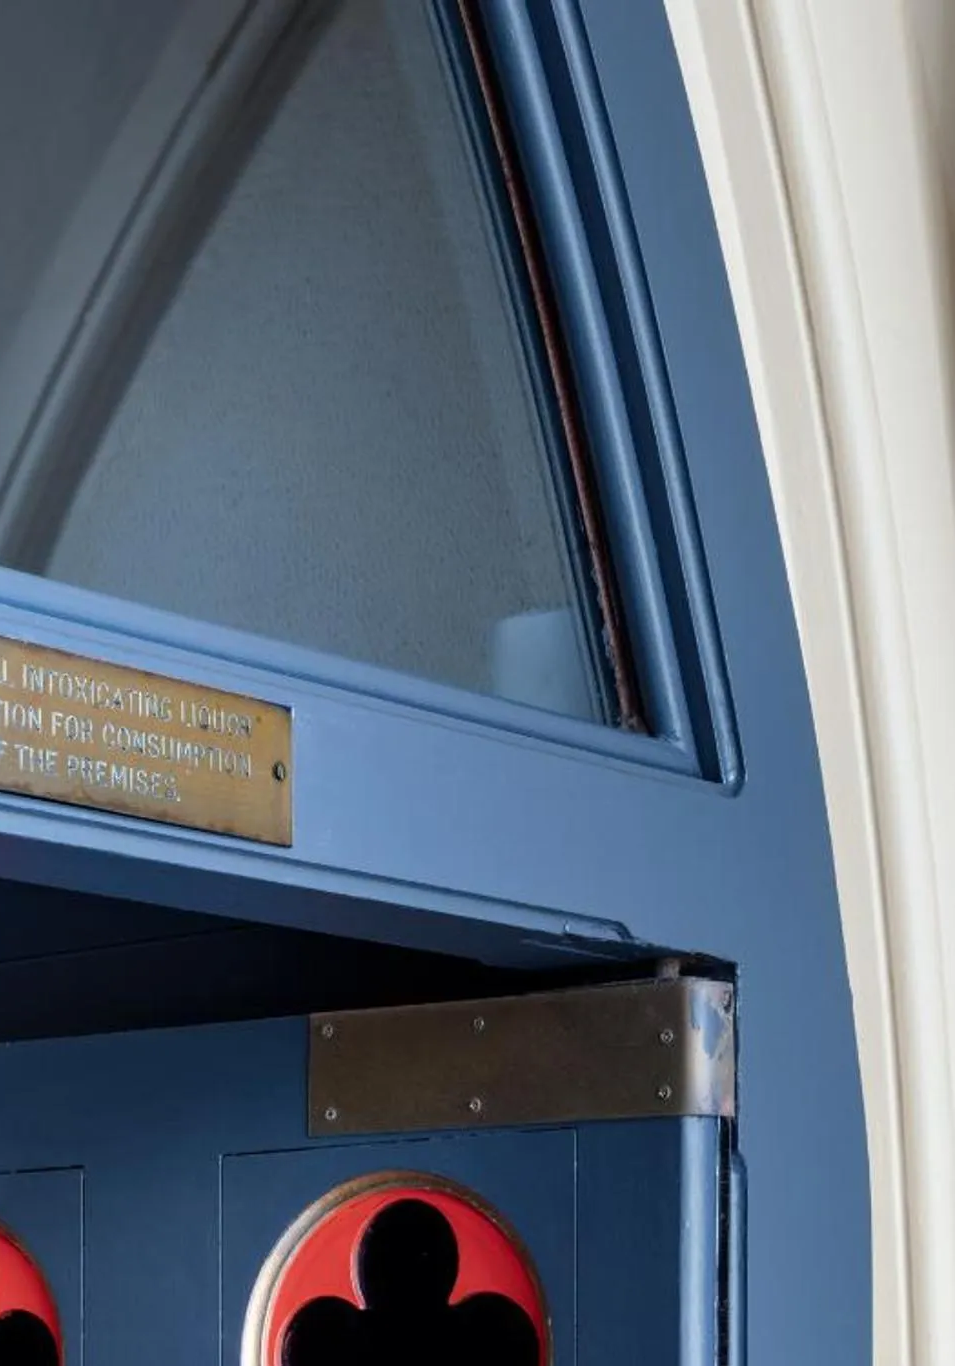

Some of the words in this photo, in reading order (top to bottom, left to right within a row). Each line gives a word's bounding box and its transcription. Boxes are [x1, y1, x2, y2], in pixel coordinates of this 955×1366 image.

[22, 664, 172, 722] INTOXICATING
[15, 744, 57, 773] THE
[51, 713, 93, 743] FOR
[102, 725, 251, 778] CONSUMPTION
